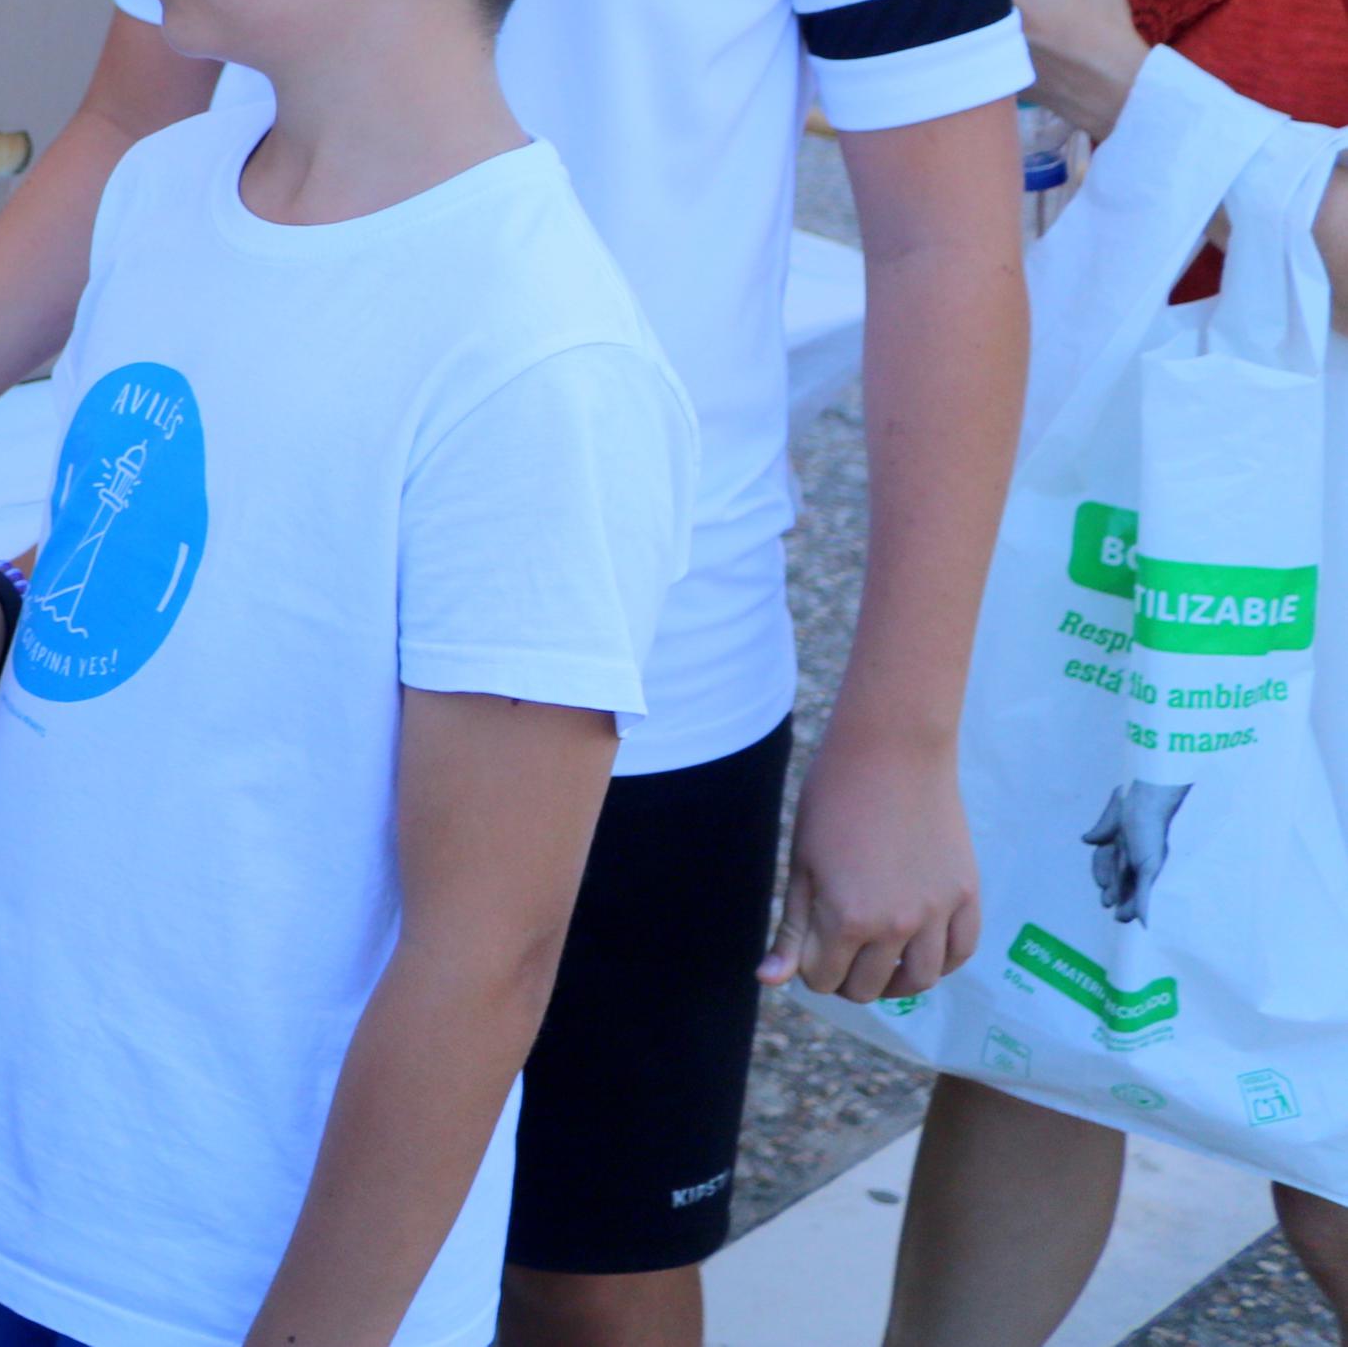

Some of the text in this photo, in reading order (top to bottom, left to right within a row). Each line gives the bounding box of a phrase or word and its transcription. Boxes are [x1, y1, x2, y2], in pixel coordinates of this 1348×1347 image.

[111, 383, 184, 440] AVILÉS
[78, 649, 118, 678] YES!
[1064, 658, 1124, 694] está
[1168, 725, 1258, 753] manos.
